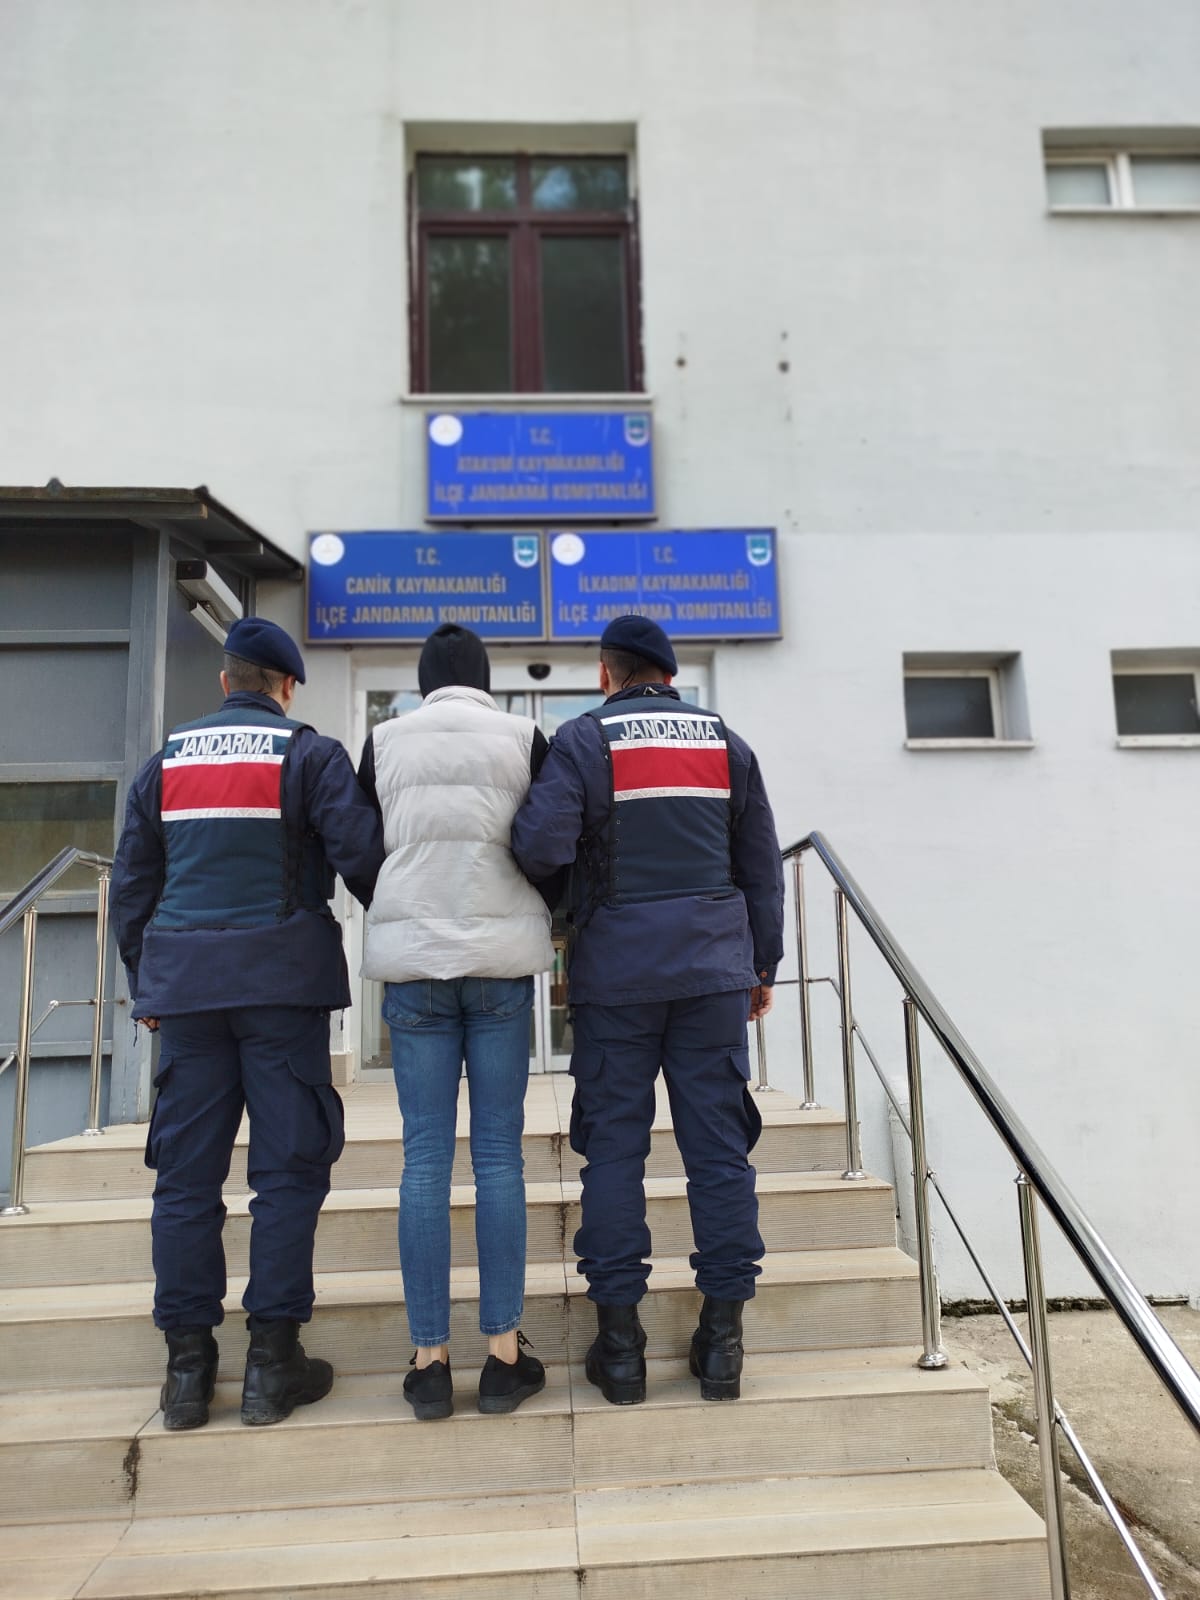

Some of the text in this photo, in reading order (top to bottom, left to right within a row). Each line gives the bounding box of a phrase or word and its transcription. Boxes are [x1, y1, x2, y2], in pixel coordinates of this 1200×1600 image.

[470, 484, 548, 502] JANDARMA
[415, 547, 441, 565] T.C.
[653, 546, 677, 563] T.C.
[346, 573, 507, 594] CANİK KAYMAKAMLIĞI
[578, 569, 749, 592] İLKADIM KAYMAKAMLIĞI
[316, 601, 537, 628] İLÇE JANDARMA KOMUTANLIĞI
[559, 601, 588, 626] İLÇE
[676, 599, 772, 619] KOMUTANLIĞI
[620, 720, 719, 740] JANDARMA
[174, 733, 274, 758] JANDARMA
